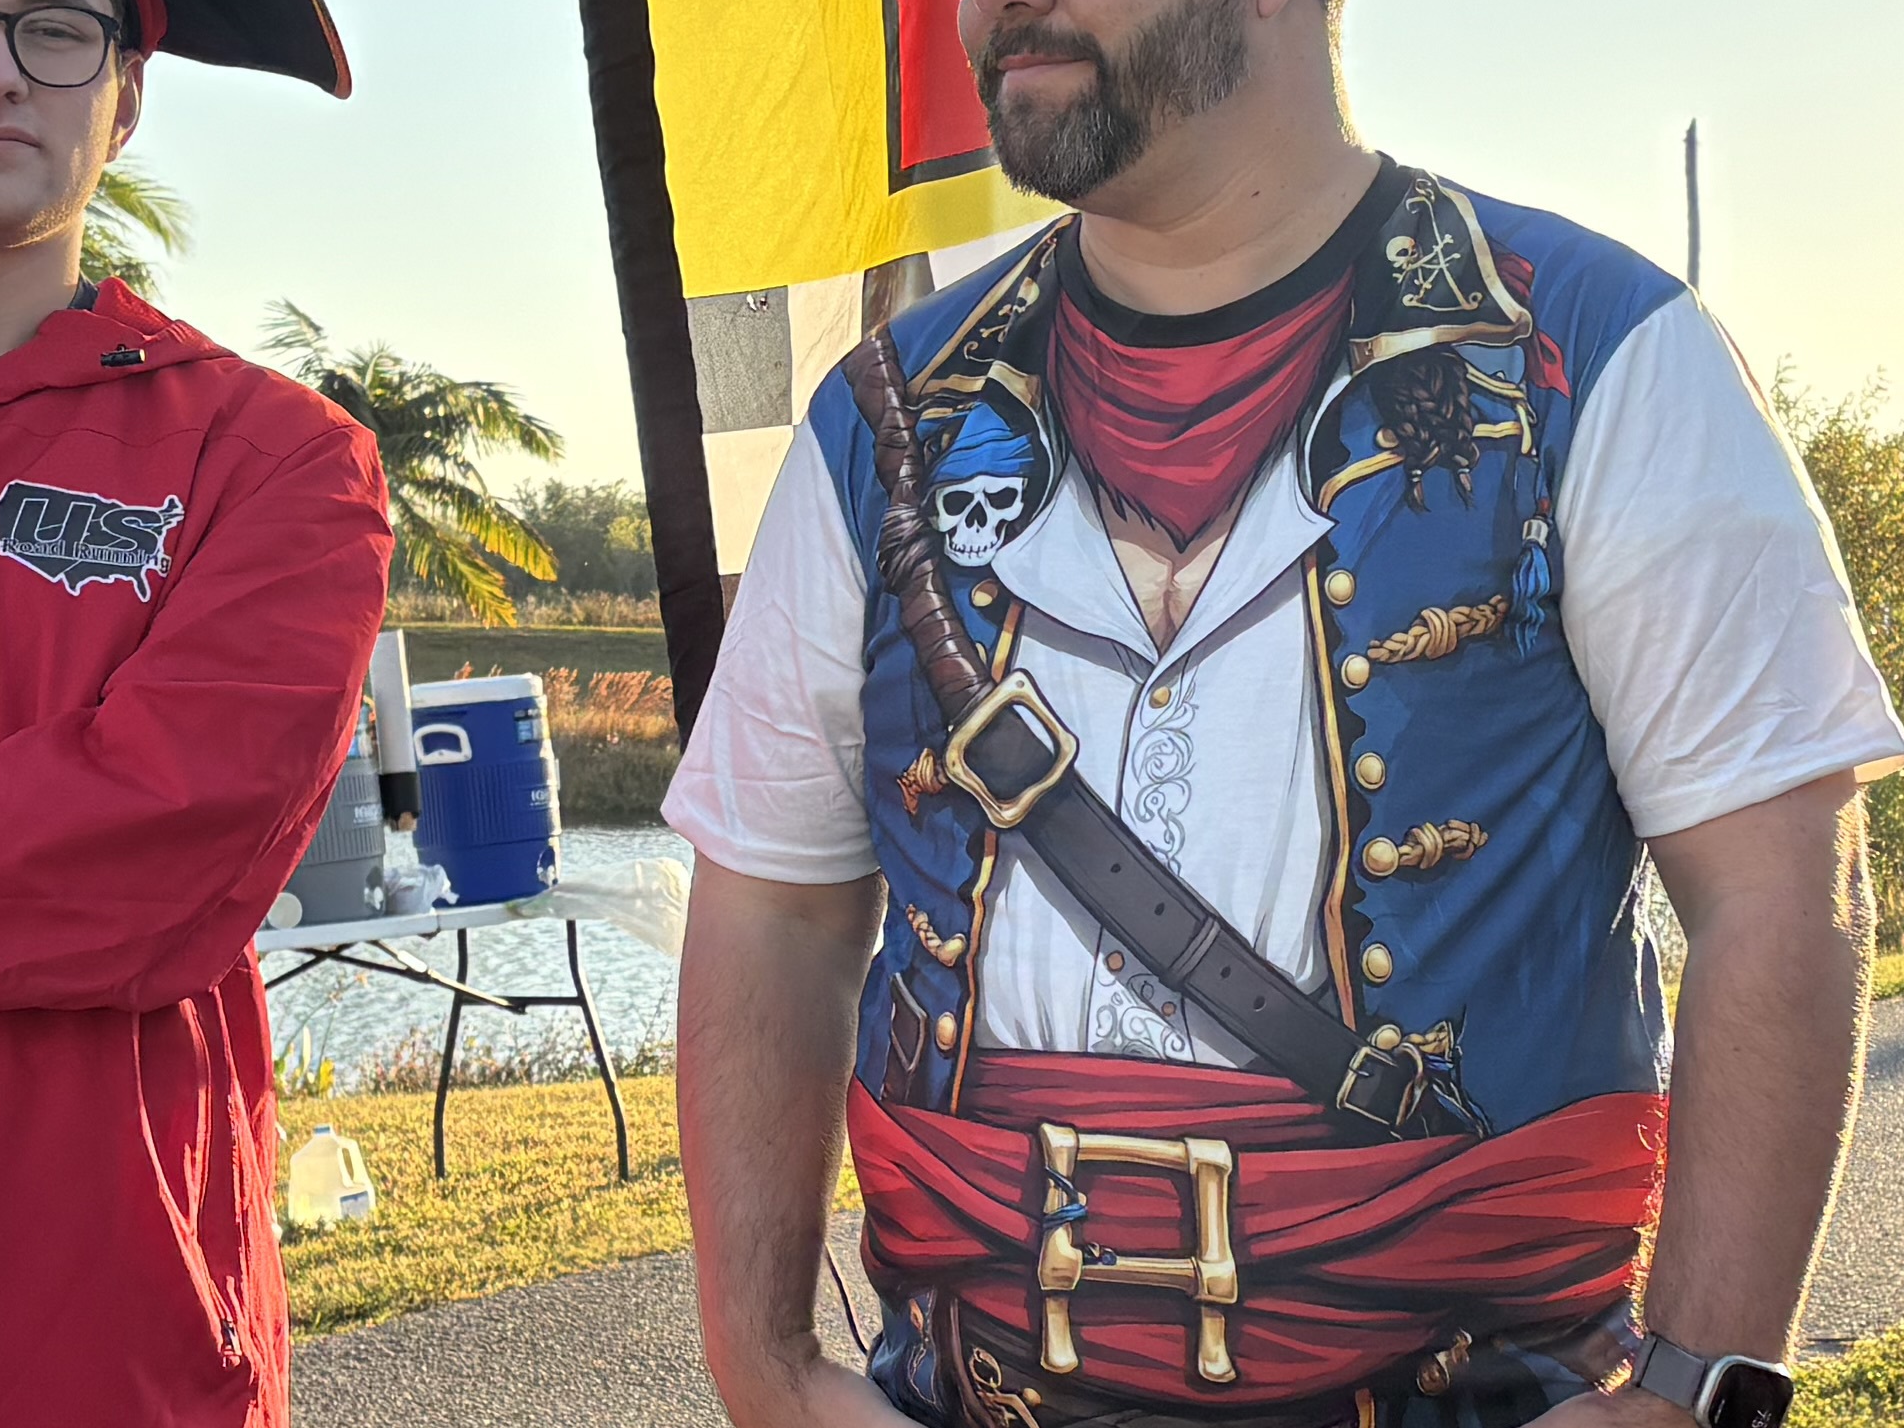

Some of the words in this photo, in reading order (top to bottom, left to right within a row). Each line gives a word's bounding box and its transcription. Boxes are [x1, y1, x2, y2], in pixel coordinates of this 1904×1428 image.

[1, 536, 66, 557] Road
[72, 541, 172, 574] Running
[9, 497, 165, 562] US
